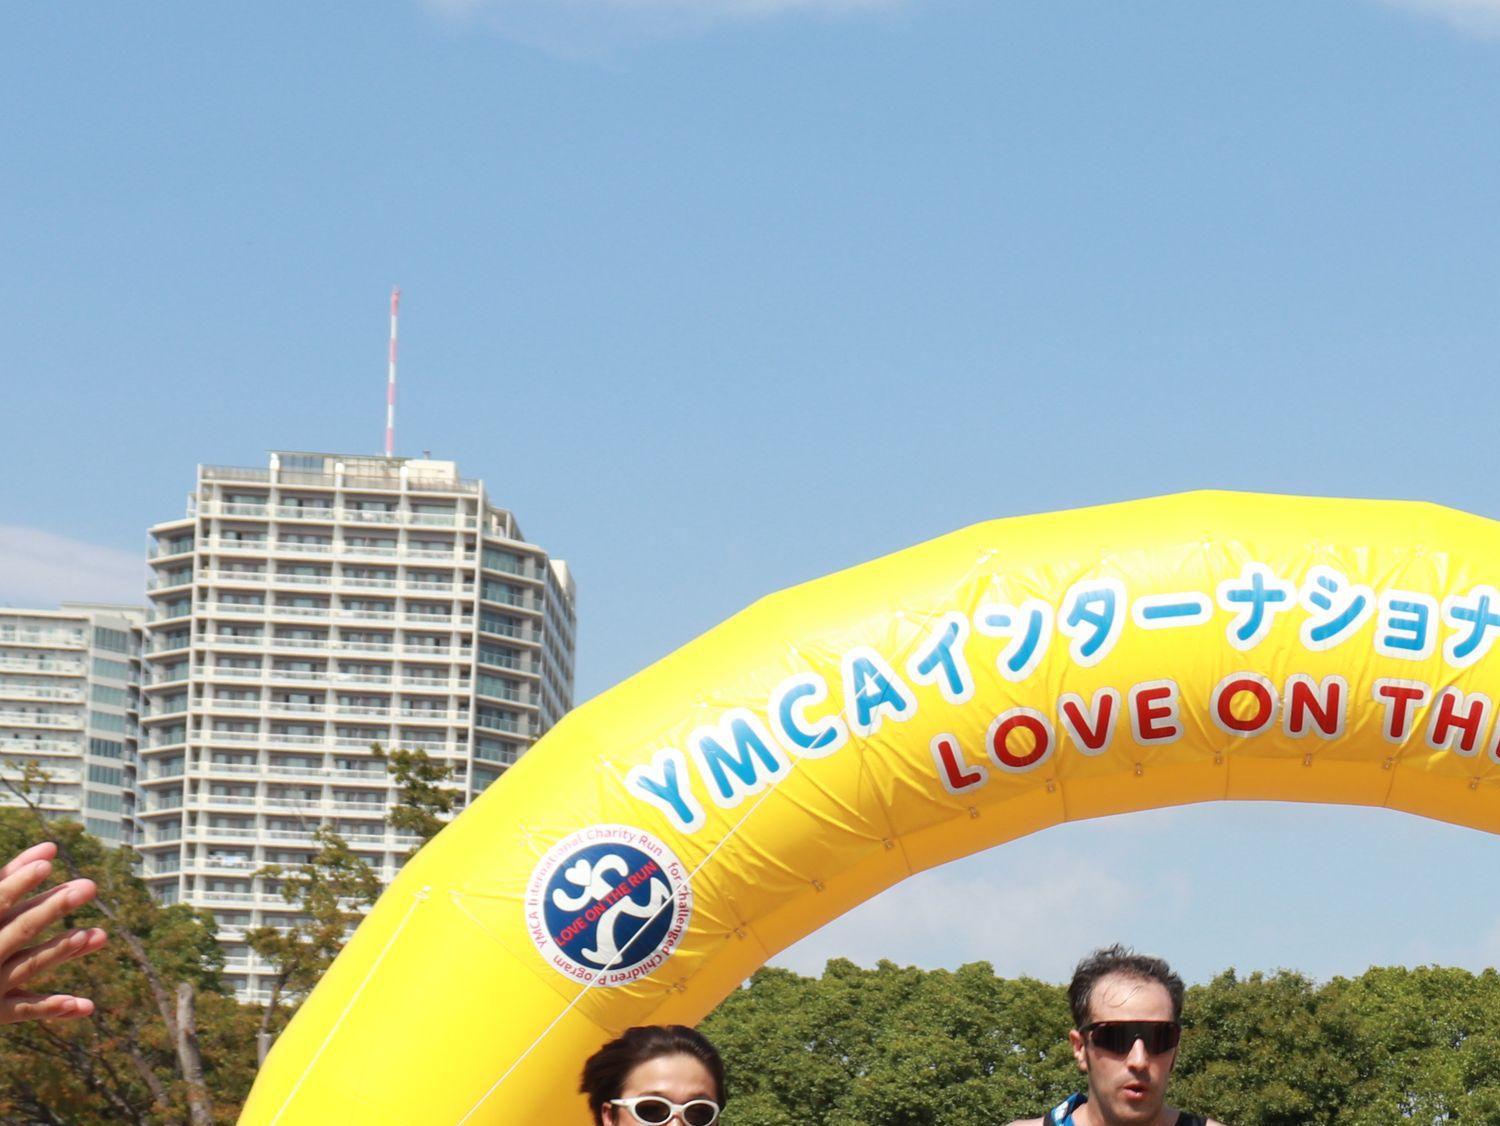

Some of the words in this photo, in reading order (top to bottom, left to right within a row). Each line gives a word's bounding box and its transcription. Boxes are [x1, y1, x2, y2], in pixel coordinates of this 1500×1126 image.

[938, 686, 1178, 790] LOVE
[1216, 679, 1342, 735] ON
[586, 827, 638, 844] Charity
[638, 835, 663, 857] Run
[667, 862, 682, 881] for
[554, 918, 589, 948] LOVE
[584, 903, 607, 922] ON
[602, 881, 632, 907] THE
[627, 861, 658, 888] RUN
[528, 911, 548, 949] YMCA
[553, 954, 607, 986] Pogram
[610, 953, 664, 984] Children
